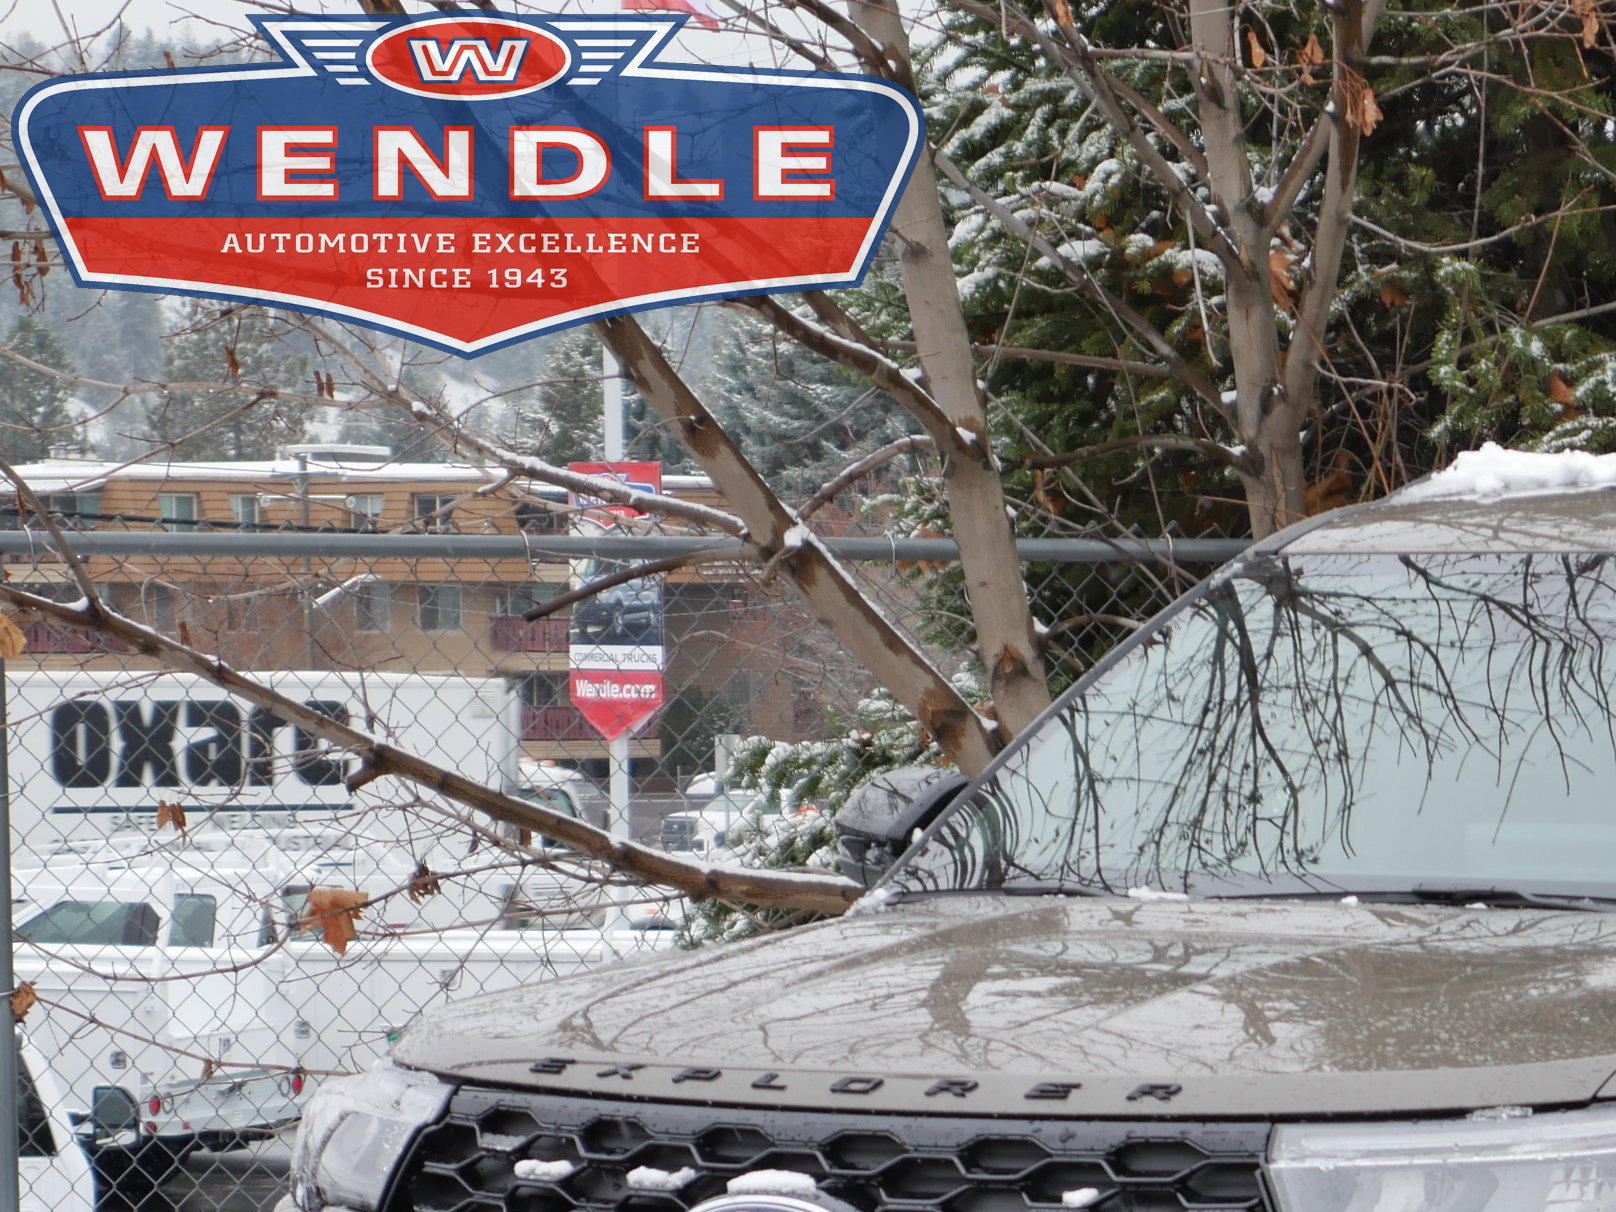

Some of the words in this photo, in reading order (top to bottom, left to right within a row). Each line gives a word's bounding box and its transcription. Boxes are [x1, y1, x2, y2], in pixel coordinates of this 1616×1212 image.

[573, 652, 619, 663] COMMERCIAL
[622, 653, 657, 663] TRUCKS
[575, 679, 657, 699] Wendle.com
[528, 1056, 1183, 1102] EXPLORER
